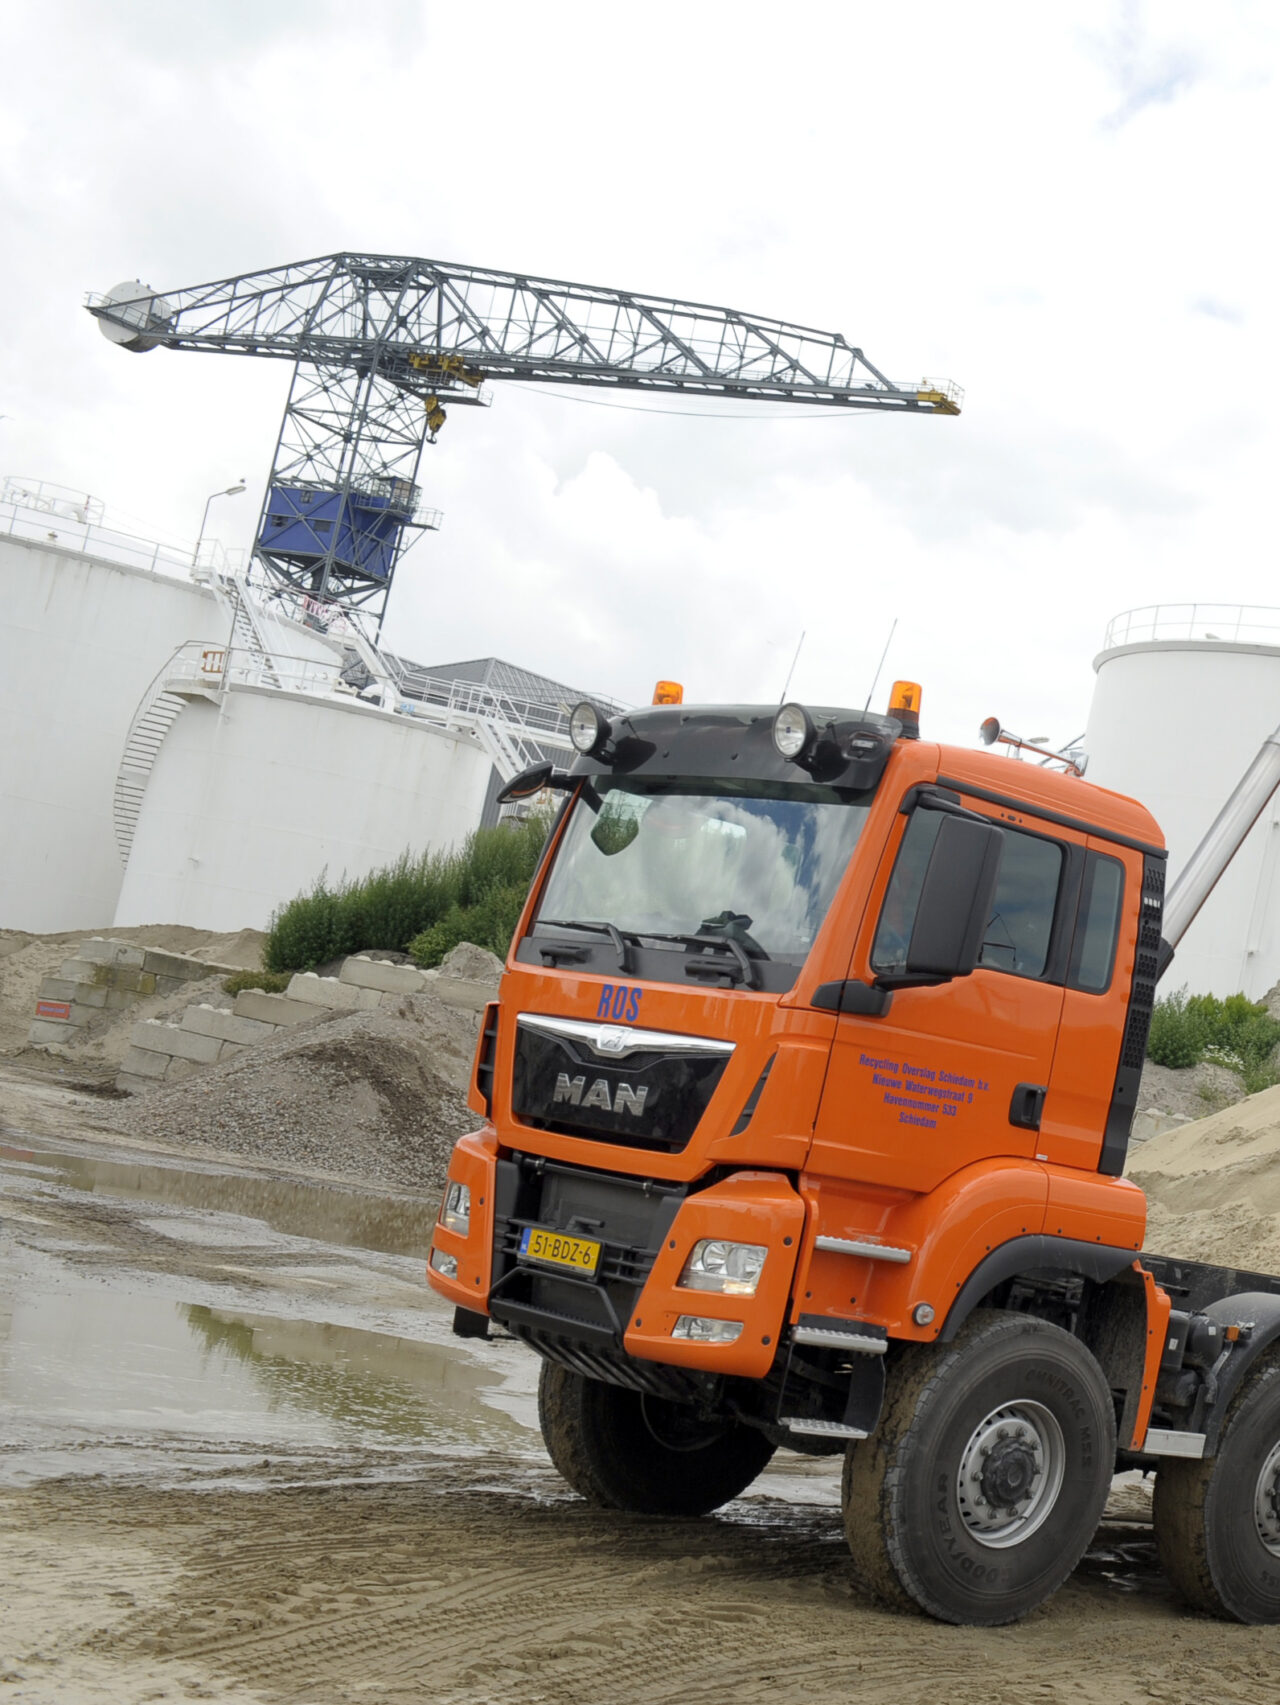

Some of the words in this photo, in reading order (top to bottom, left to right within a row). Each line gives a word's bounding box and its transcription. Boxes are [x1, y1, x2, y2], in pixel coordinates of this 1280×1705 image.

[596, 983, 643, 1022] ROS
[859, 1053, 898, 1073] Recycling
[902, 1062, 935, 1081] Overslag
[938, 1070, 975, 1088] Schiedam
[872, 1073, 902, 1090] Nieuwe
[552, 1072, 649, 1117] MAN
[883, 1092, 939, 1113] Havennummer
[941, 1103, 957, 1116] 533
[898, 1111, 936, 1128] Schiedam
[533, 1234, 591, 1264] 51-BDZ-6
